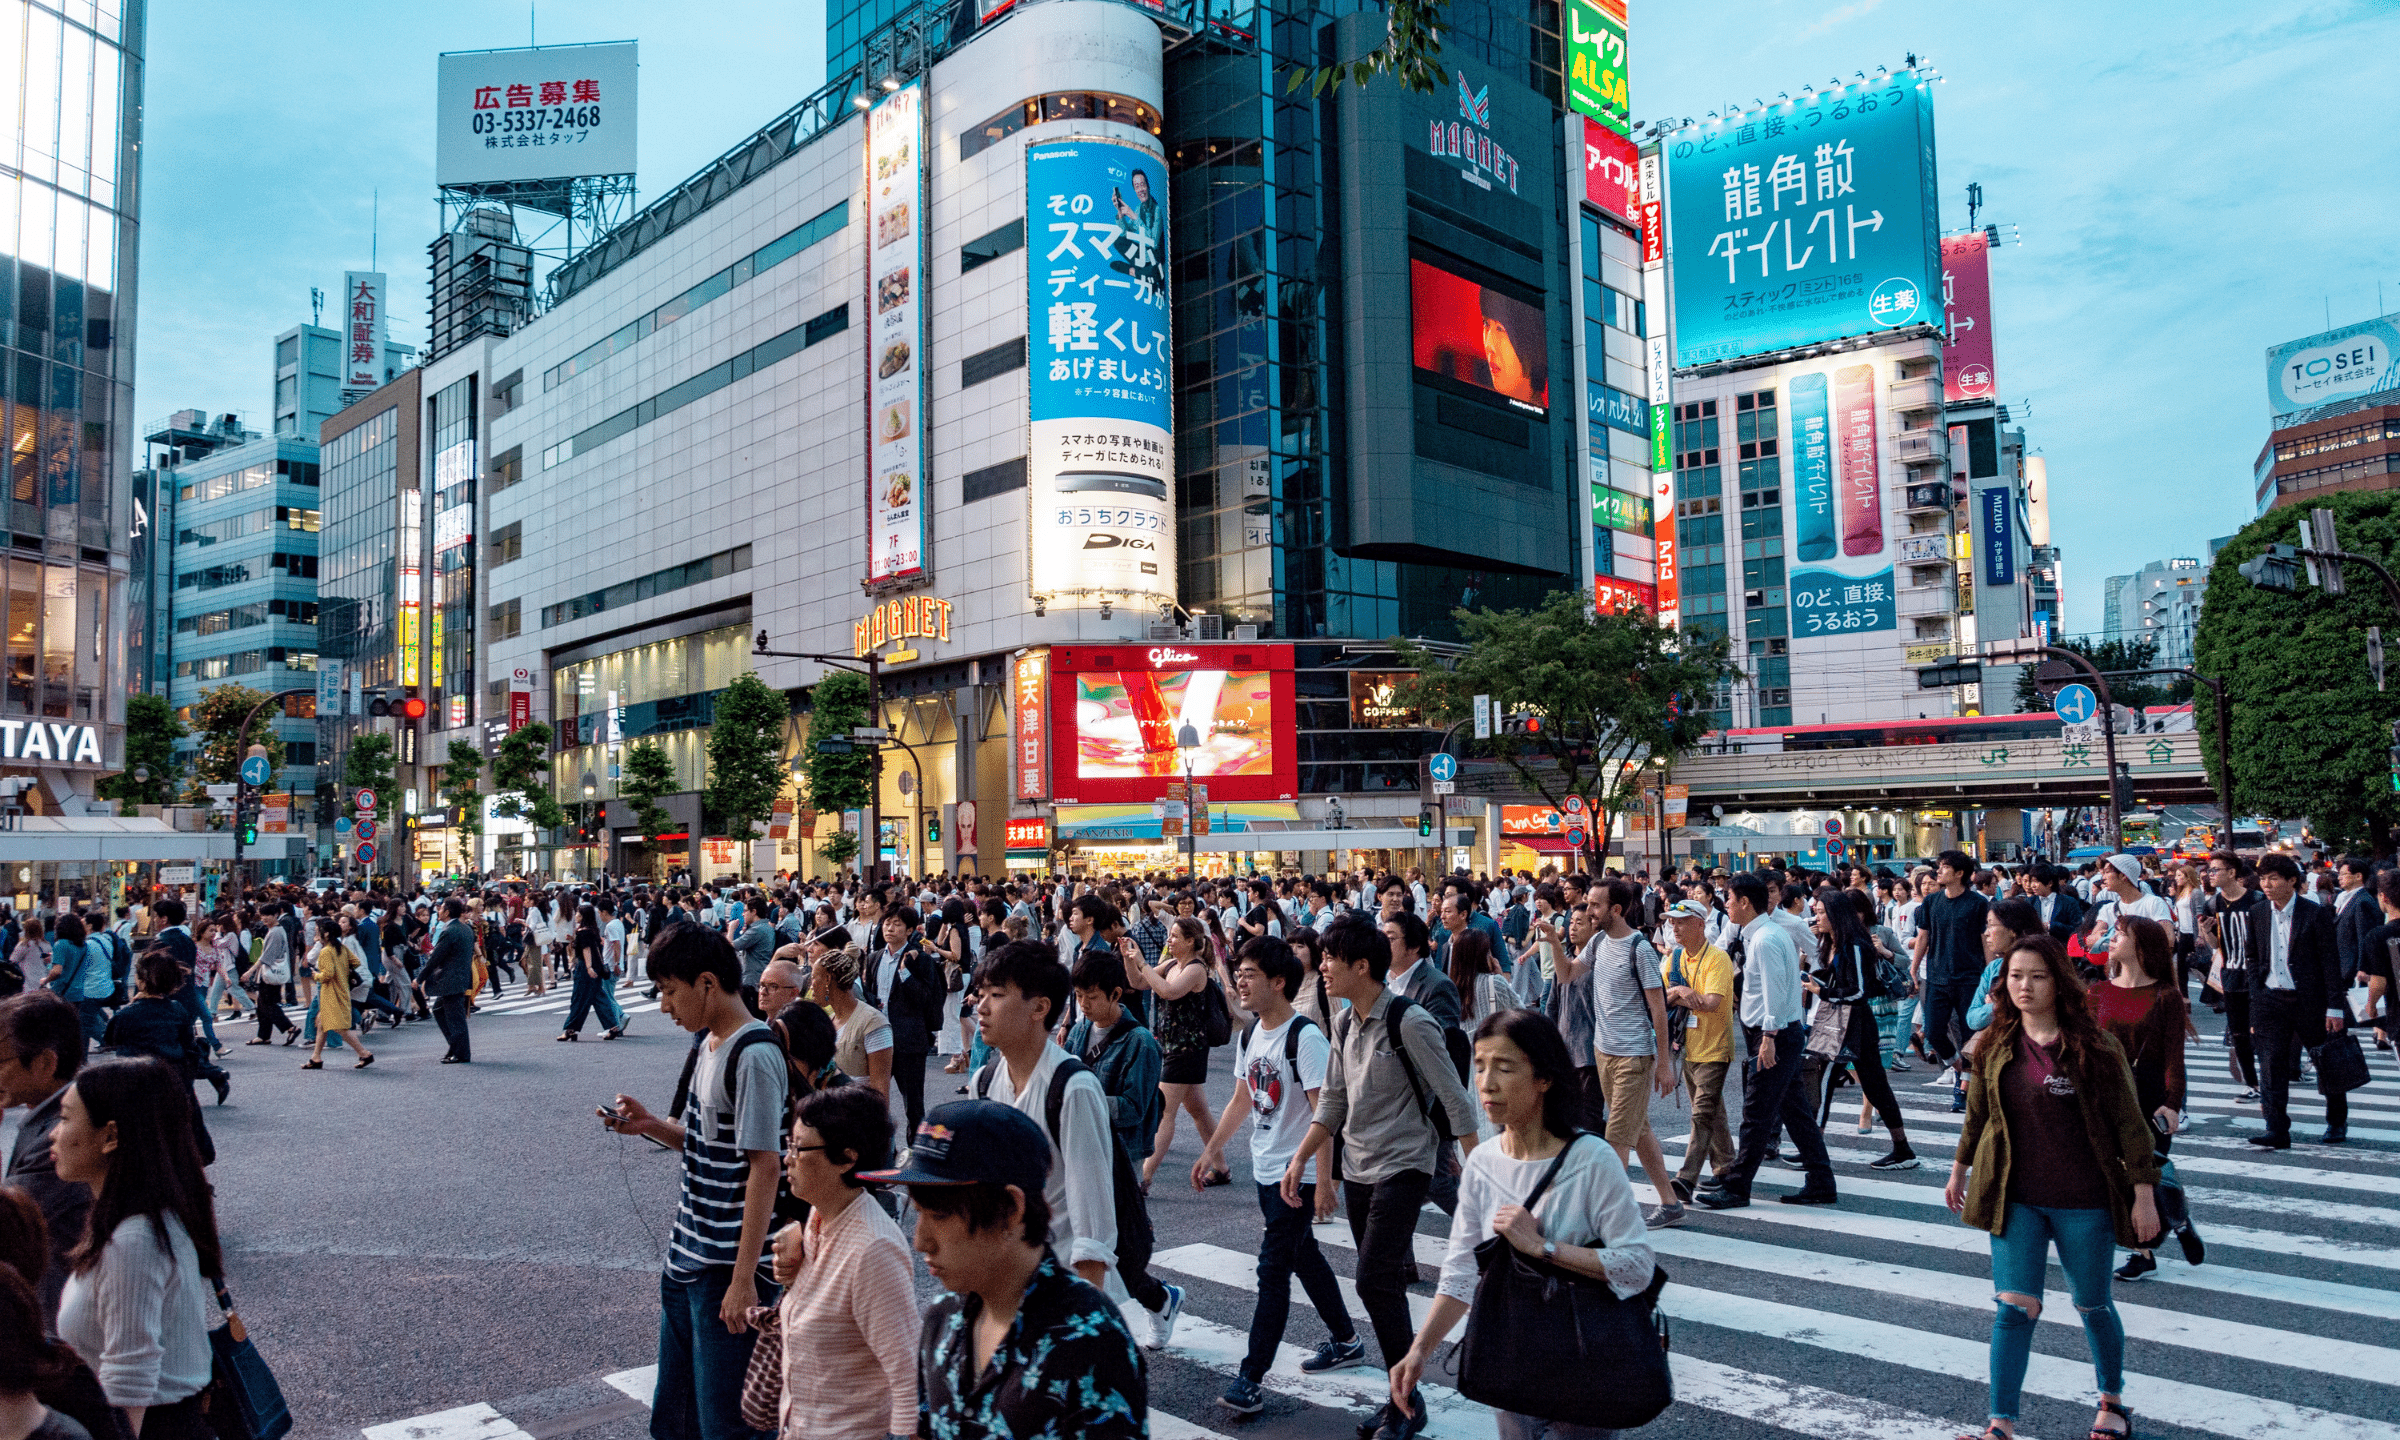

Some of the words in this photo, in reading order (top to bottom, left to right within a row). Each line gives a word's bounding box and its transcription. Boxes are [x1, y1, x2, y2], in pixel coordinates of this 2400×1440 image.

[1571, 8, 1625, 68] レイク
[473, 79, 601, 110] 広告募集
[1571, 51, 1628, 111] ALSA
[472, 105, 601, 134] 03-5337-2468
[1674, 85, 1905, 160] のど、直接、うるおう
[485, 130, 590, 149] 株式会社タップ
[1033, 149, 1079, 161] Panasonic
[1430, 119, 1519, 195] MAGNET
[1586, 143, 1638, 192] アイフル
[1723, 138, 1856, 222] 龍角散
[1047, 193, 1094, 216] その
[1646, 216, 1660, 260] アイフル
[1707, 204, 1885, 284] ダイレクト
[1047, 265, 1165, 310] ディーガが
[1724, 283, 1797, 311] スティック
[1803, 279, 1832, 292] ミント
[1838, 272, 1863, 287] 16包
[1873, 289, 1916, 316] 生薬
[352, 281, 375, 364] 大和証券
[1048, 301, 1165, 363] 軽くして
[1653, 341, 1664, 402] レオパレス21
[2292, 346, 2375, 380] TOSEI
[1960, 370, 1989, 387] 生薬
[2294, 366, 2376, 394] トーセイ株式会社
[1075, 387, 1156, 405] ※データ容量において
[1655, 406, 1665, 431] レイク
[1061, 434, 1164, 455] スマホの写真や動画は
[1656, 431, 1666, 466] ALSA
[1062, 450, 1164, 471] ディーガにためられる!
[1058, 509, 1167, 532] おうちクラウド
[1592, 493, 1620, 515] レイク
[1620, 500, 1650, 522] ALSA
[1992, 494, 2004, 533] MIZUHO
[888, 534, 899, 549] 7F
[1082, 533, 1156, 551] DIGA
[1659, 540, 1674, 580] アコム
[1796, 582, 1893, 609] のど、直接、
[854, 595, 951, 658] MAGNET
[1806, 608, 1879, 633] うるおう
[1148, 647, 1199, 668] Glico
[1963, 646, 1975, 657] 3F
[1020, 680, 1041, 795] 天津甘栗
[1981, 743, 2009, 764] JR
[1008, 825, 1044, 841] 天津甘栗
[1076, 828, 1134, 837] SANZENRI
[1093, 852, 1117, 861] TAX
[1121, 852, 1147, 861] Free
